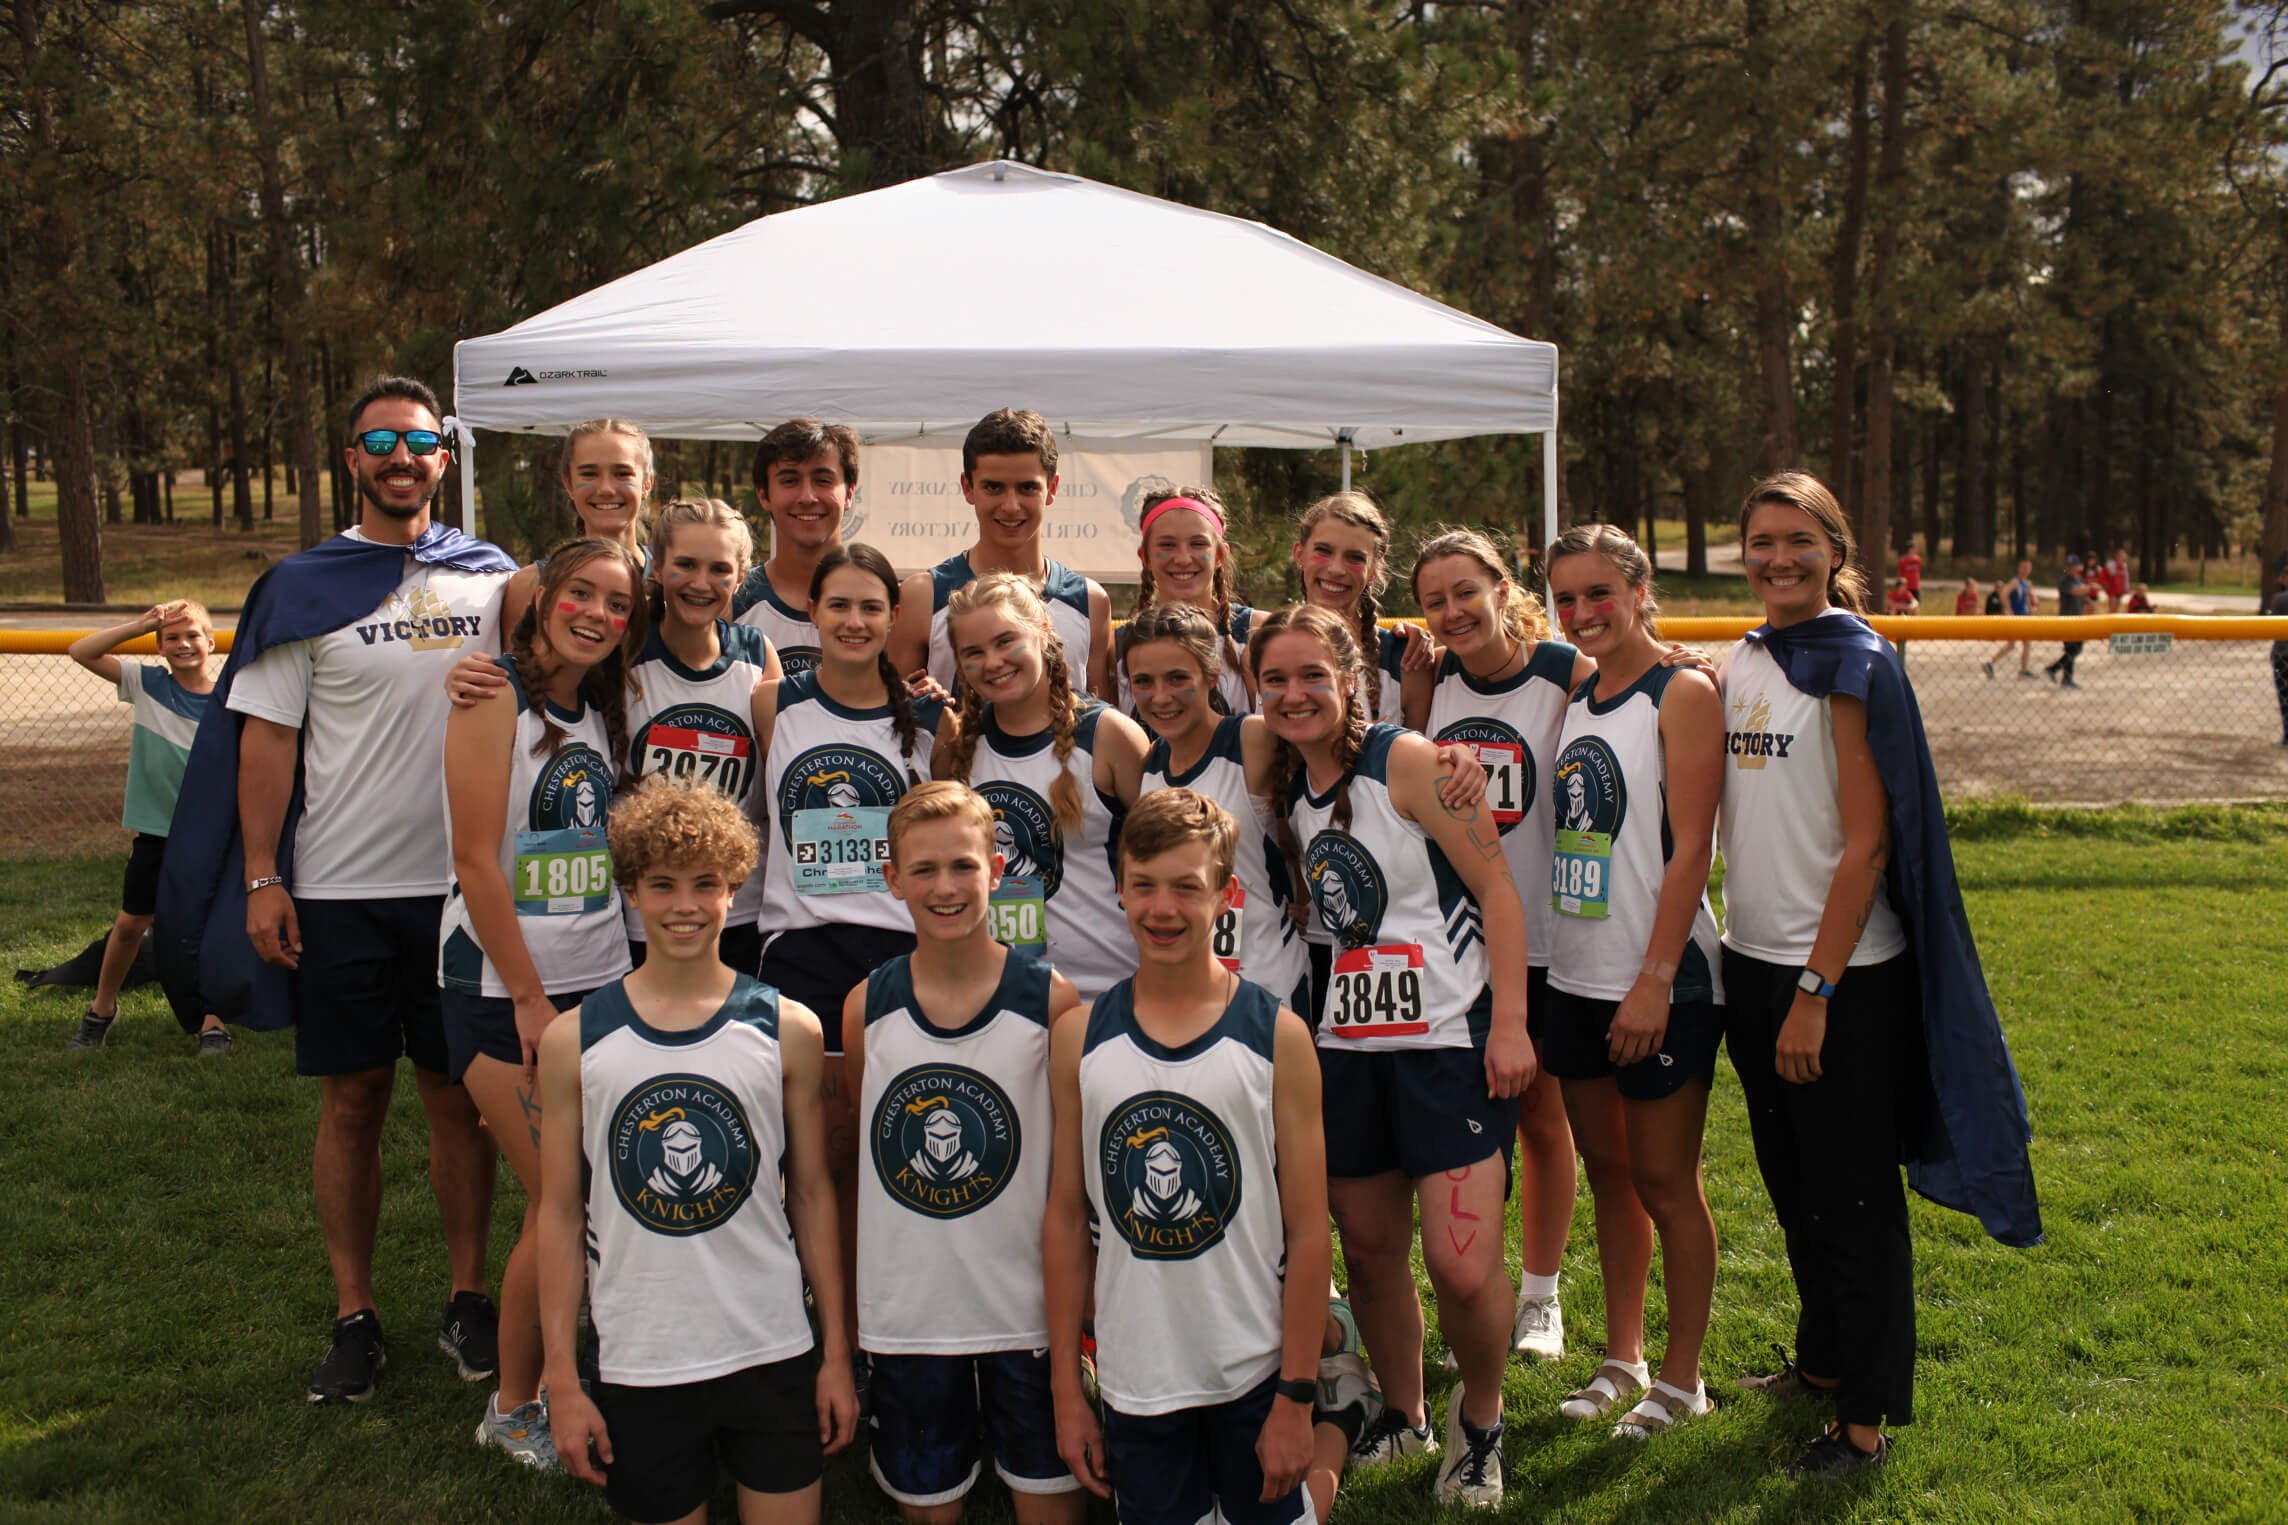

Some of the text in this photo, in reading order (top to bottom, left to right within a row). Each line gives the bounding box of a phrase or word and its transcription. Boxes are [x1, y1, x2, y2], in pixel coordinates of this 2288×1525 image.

[356, 616, 481, 645] VICTORY
[1724, 731, 1794, 758] ICTORY
[787, 755, 896, 810] CHESTERTON ACADEM
[1011, 797, 1050, 848] ACADEMY
[820, 838, 871, 864] 3133
[1332, 842, 1374, 889] ACADEMY
[524, 854, 607, 896] 1805
[1553, 855, 1601, 898] 3189
[986, 903, 1037, 941] 850
[1333, 969, 1422, 1025] 3849
[618, 1088, 747, 1160] CHESTERTON ACADEMY
[882, 1077, 953, 1139] CHESTERTON
[956, 1081, 1007, 1141] ACADEMY
[1107, 1106, 1228, 1179] CHESTERTON ACADEMY
[636, 1183, 737, 1221] KNIGHTS
[895, 1167, 993, 1206] KNIGHTS
